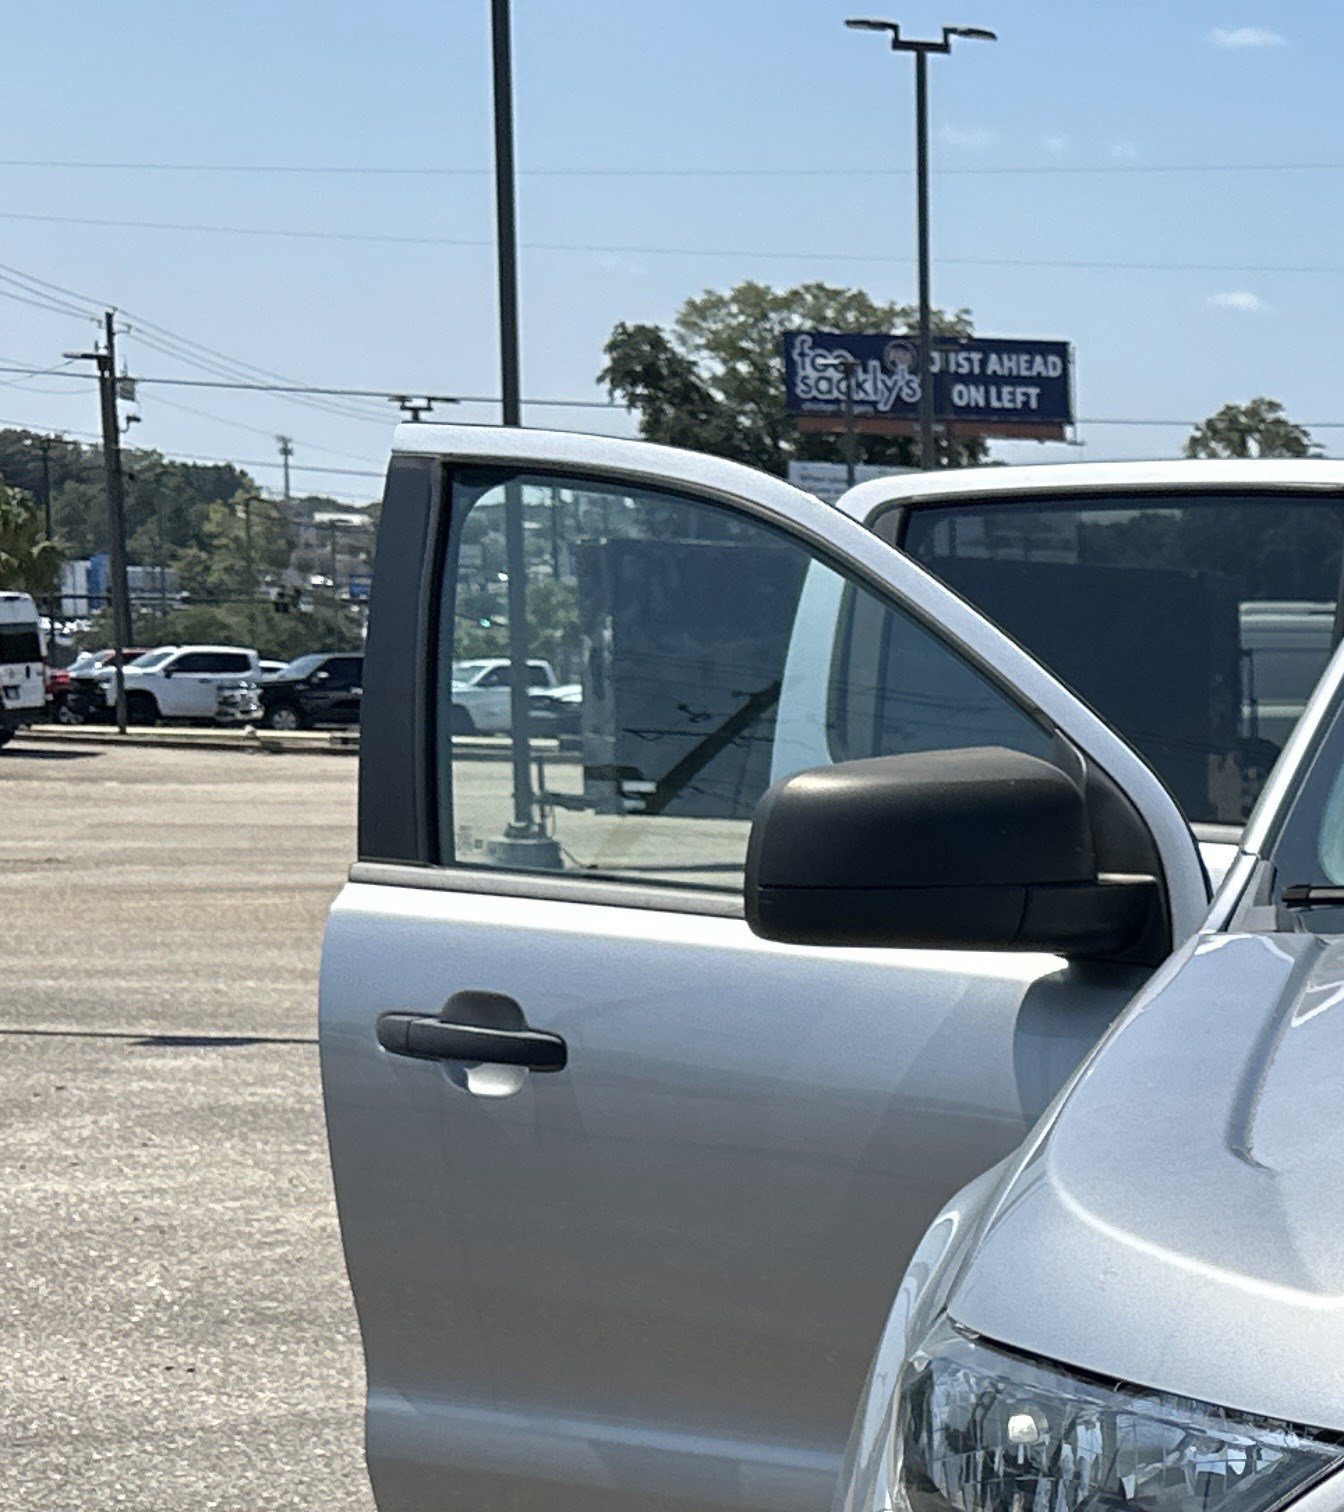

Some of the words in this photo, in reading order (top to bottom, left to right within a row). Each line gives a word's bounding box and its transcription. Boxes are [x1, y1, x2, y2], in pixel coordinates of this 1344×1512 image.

[986, 352, 1063, 377] AHEAD
[952, 383, 985, 408] ON
[988, 384, 1041, 410] LEFT
